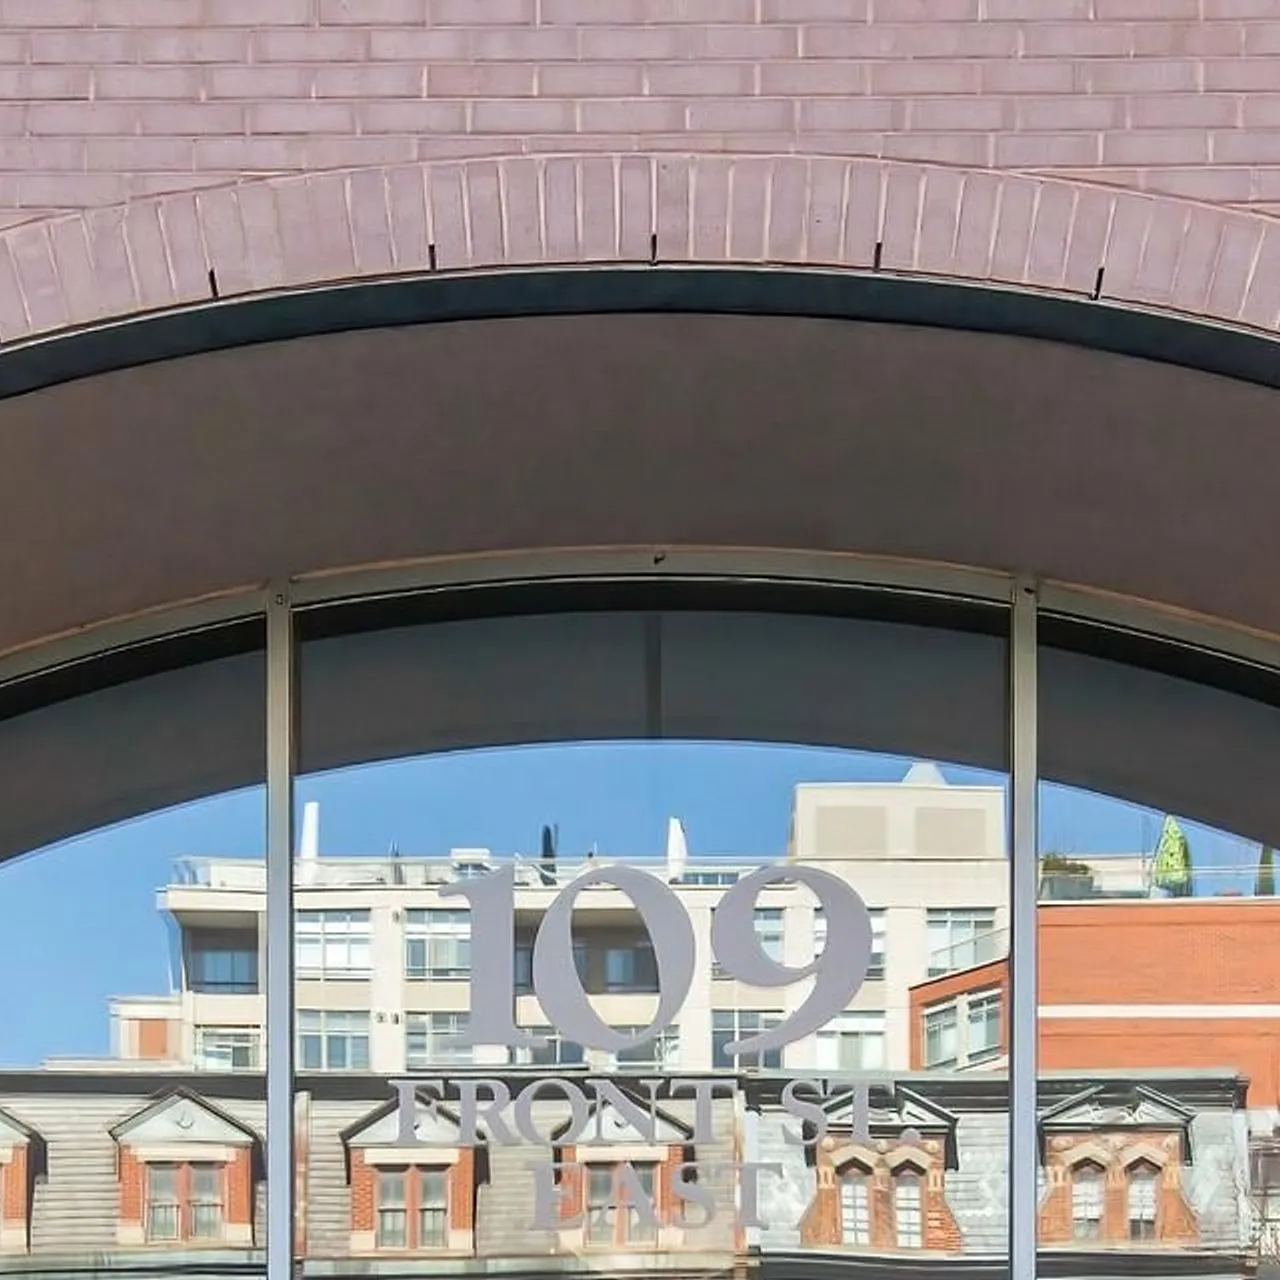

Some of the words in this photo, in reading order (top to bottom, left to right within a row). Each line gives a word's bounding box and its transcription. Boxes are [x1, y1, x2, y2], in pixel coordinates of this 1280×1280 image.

[438, 864, 874, 1056] 109
[387, 1078, 739, 1146] FRONT
[781, 1078, 919, 1147] ST.
[527, 1160, 786, 1232] EAST
